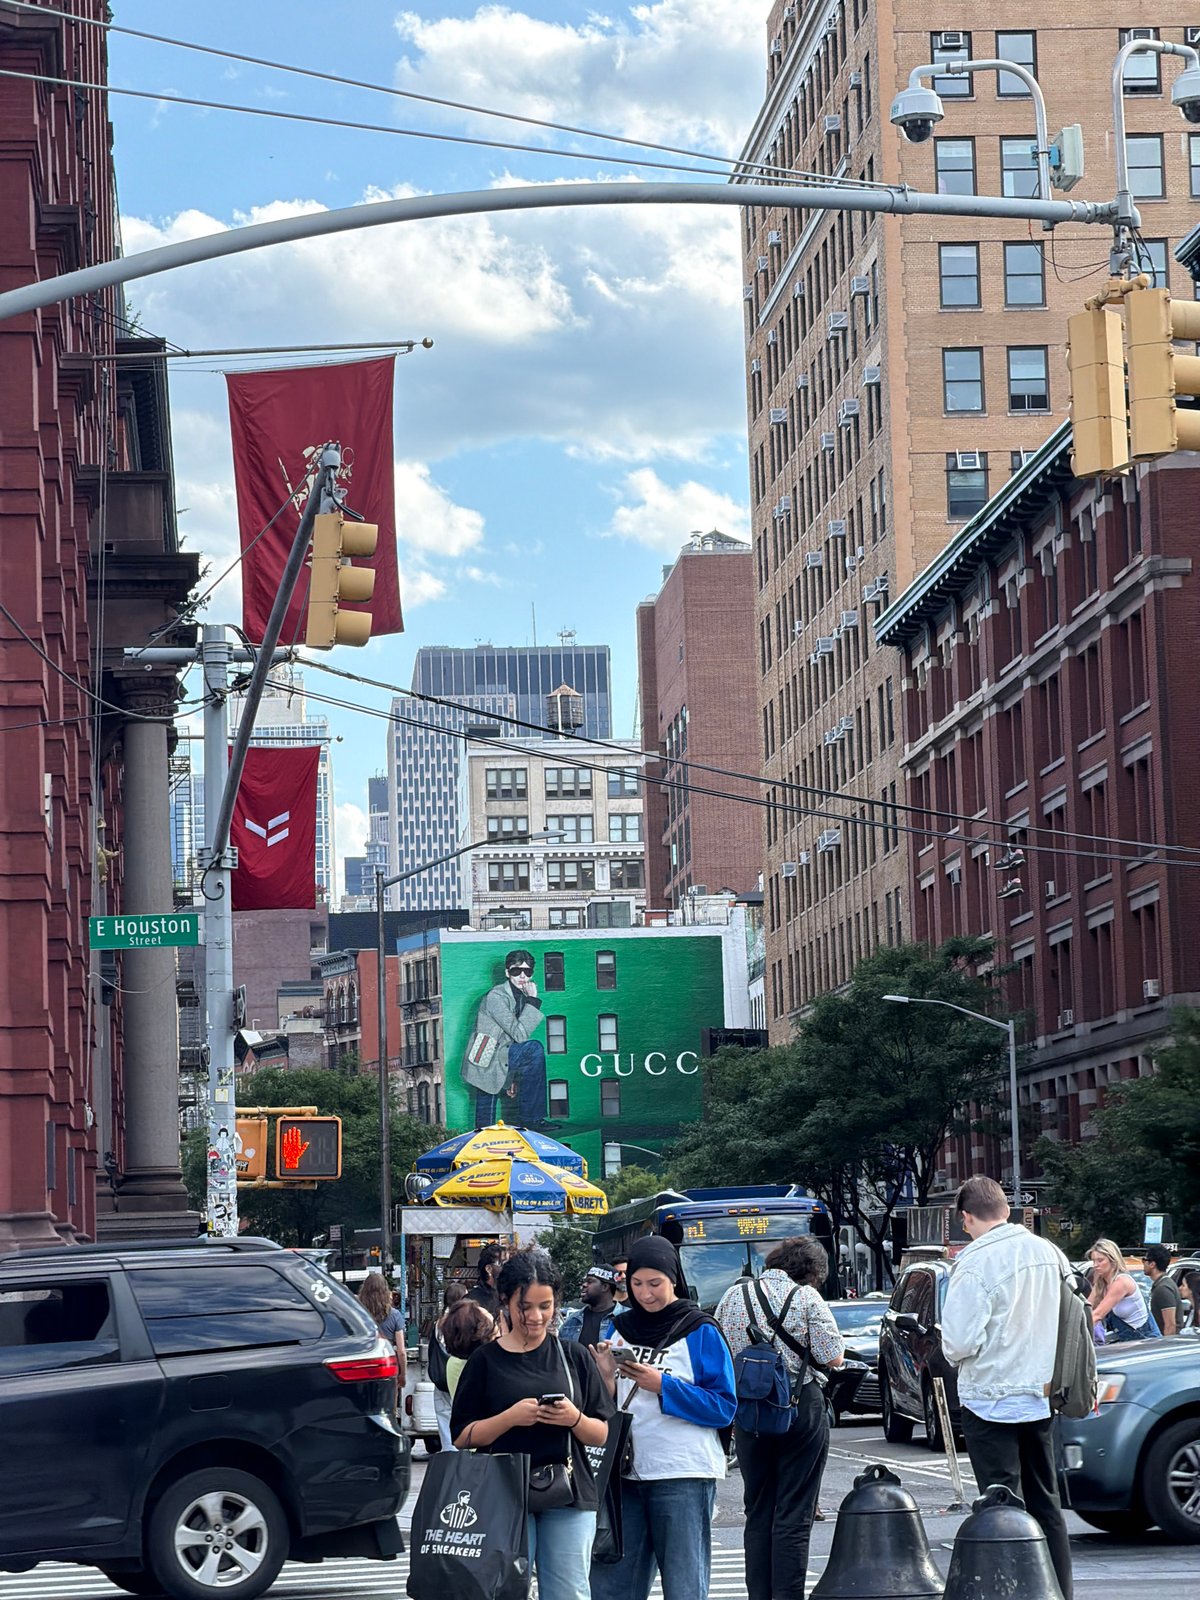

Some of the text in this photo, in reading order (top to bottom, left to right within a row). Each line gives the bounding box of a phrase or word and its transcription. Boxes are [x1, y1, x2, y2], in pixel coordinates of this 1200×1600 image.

[97, 918, 191, 936] E Houston
[129, 936, 161, 946] Street
[580, 1051, 699, 1077] GUCC
[472, 1139, 522, 1150] SABRETT
[456, 1171, 507, 1183] SABRETT
[424, 1529, 486, 1546] THE HEART
[420, 1544, 482, 1558] OF SNEAKERS
